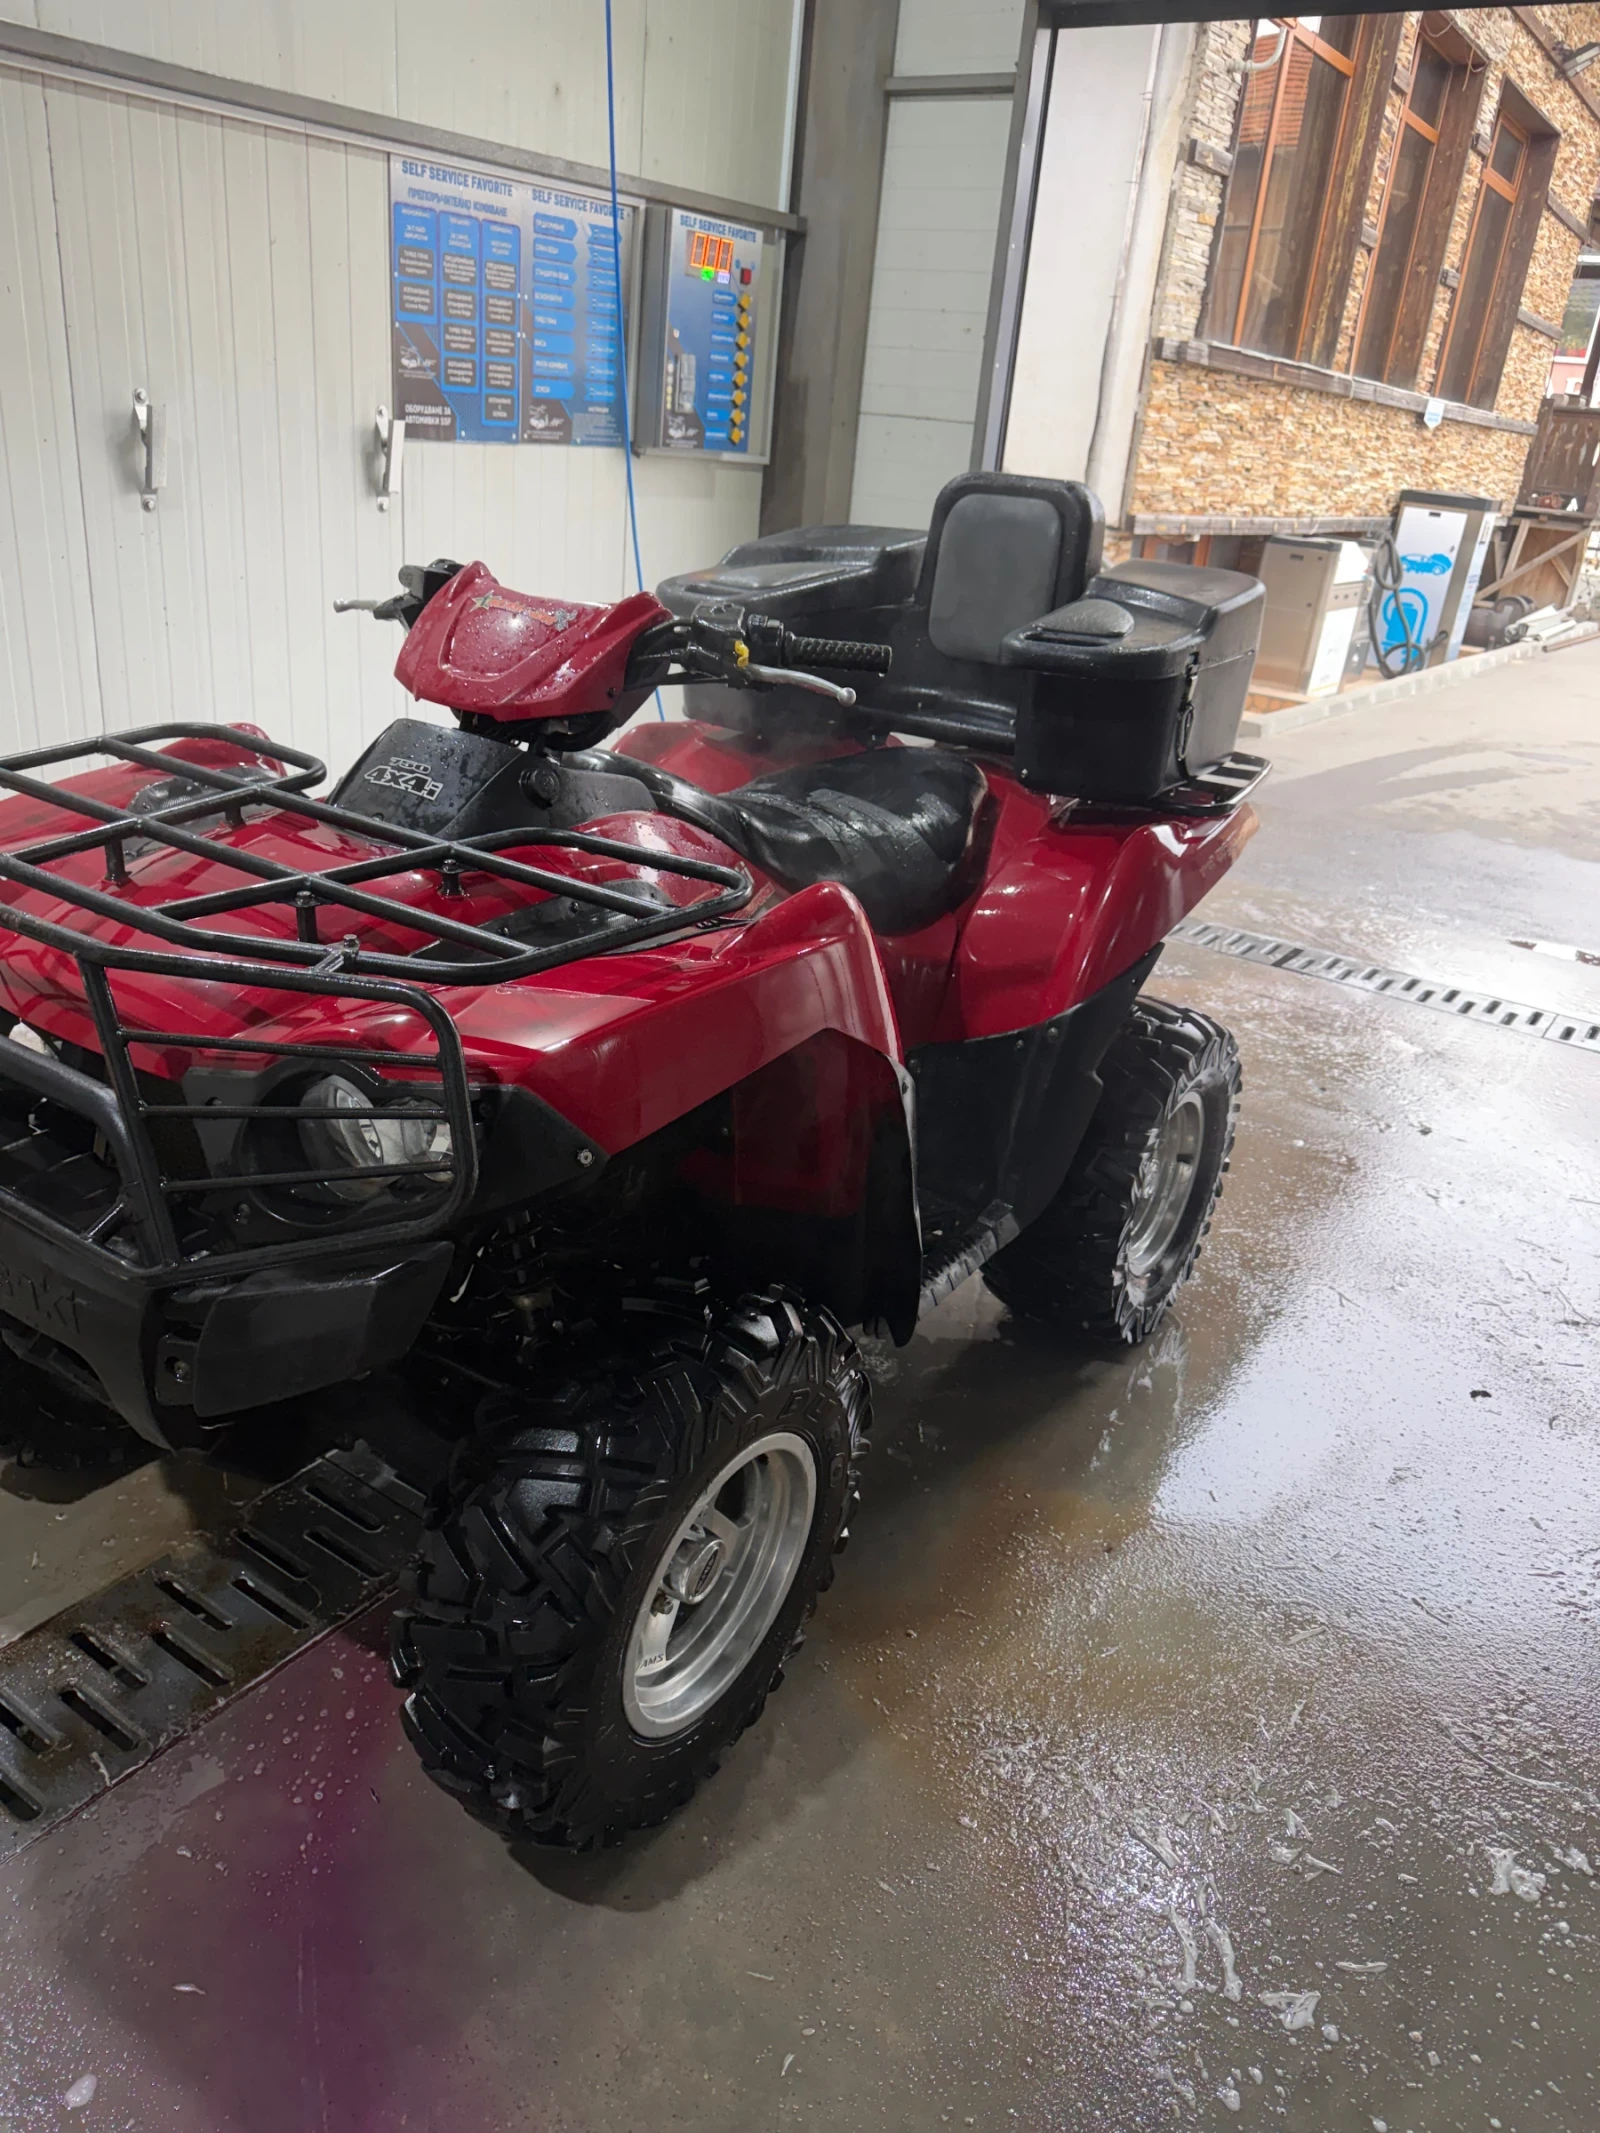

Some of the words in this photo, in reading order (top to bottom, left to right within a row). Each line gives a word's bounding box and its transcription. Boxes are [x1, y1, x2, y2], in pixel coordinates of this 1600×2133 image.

[401, 160, 428, 178] SELF
[428, 166, 470, 188] SERVICE
[471, 175, 513, 197] FAVORITE
[531, 188, 553, 205] SELF
[553, 193, 588, 212] SERVICE
[589, 201, 625, 220] FAVORTE
[680, 214, 698, 229] SELF
[698, 218, 726, 235] SERVICE
[727, 225, 757, 243] FAVORITE
[389, 757, 431, 774] 750
